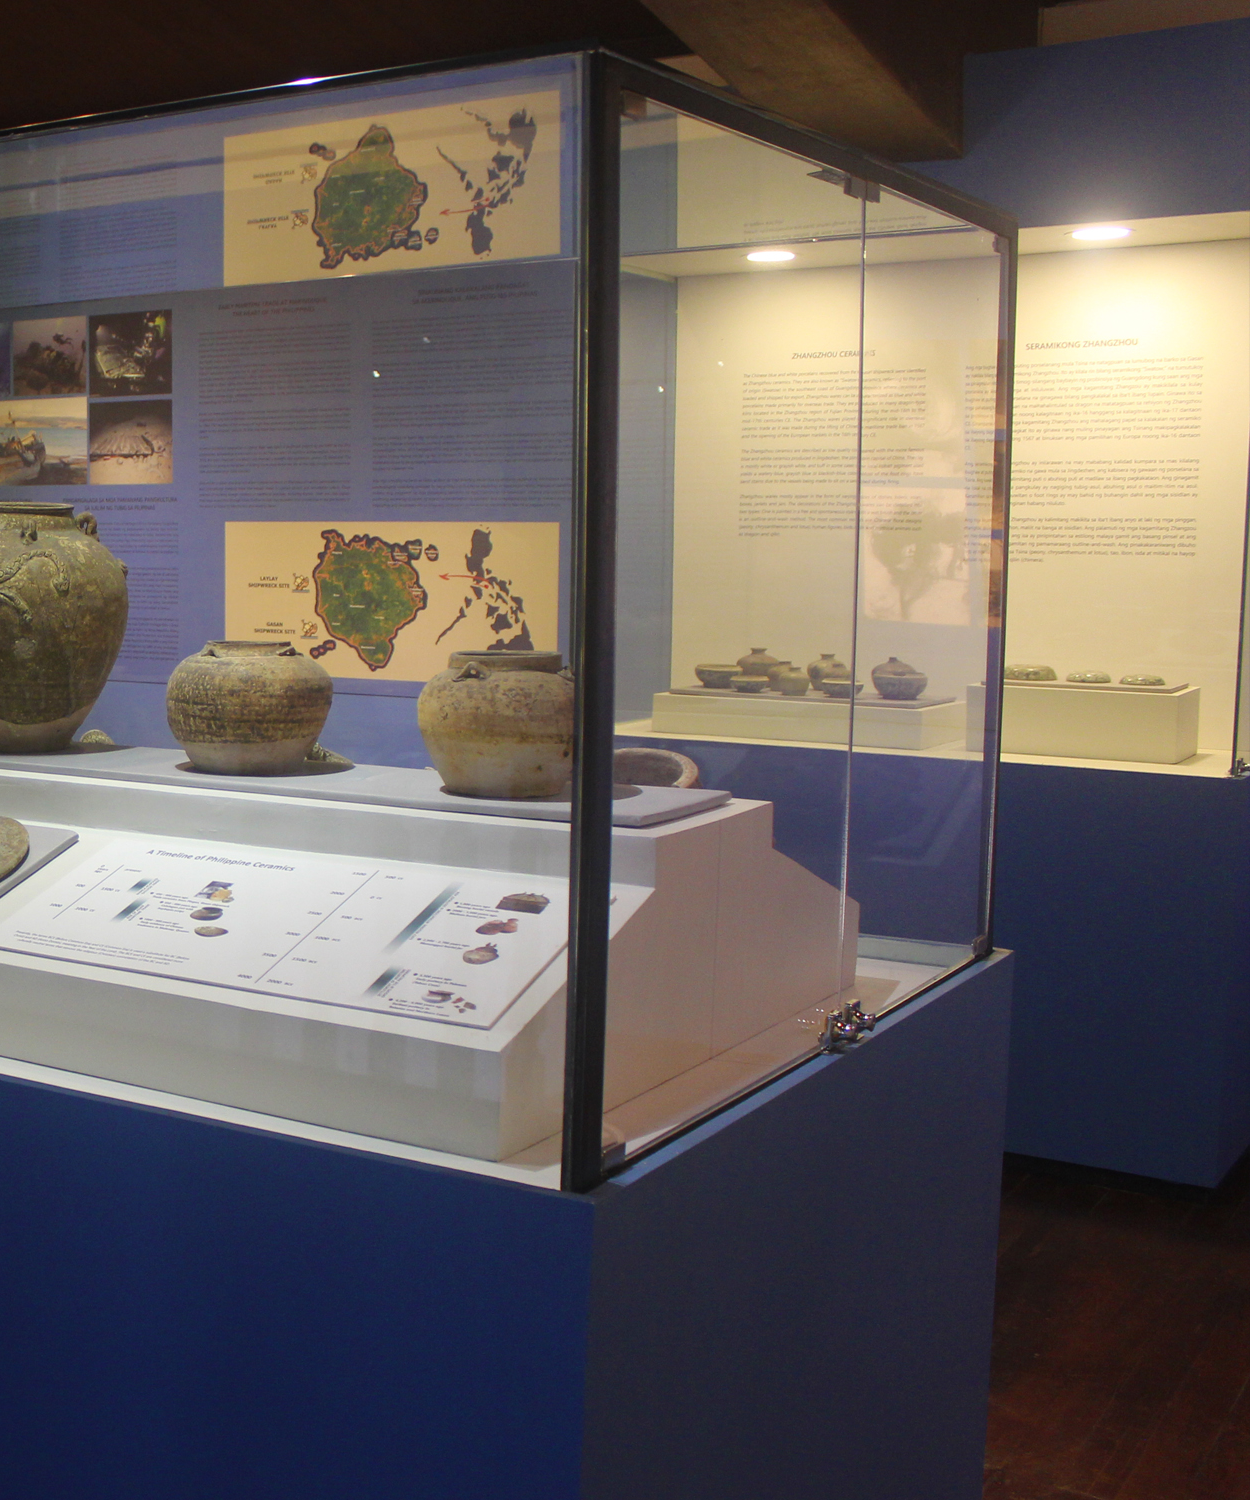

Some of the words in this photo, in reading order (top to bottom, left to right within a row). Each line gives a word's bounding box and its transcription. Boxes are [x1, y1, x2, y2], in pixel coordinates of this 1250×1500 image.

[1025, 341, 1081, 350] SERAMIKONG
[1082, 338, 1139, 348] ZHANGZHOU
[791, 351, 838, 360] ZHANGZHOU
[156, 850, 193, 860] Timeline
[205, 855, 252, 868] Philippine
[252, 862, 295, 873] Ceramics
